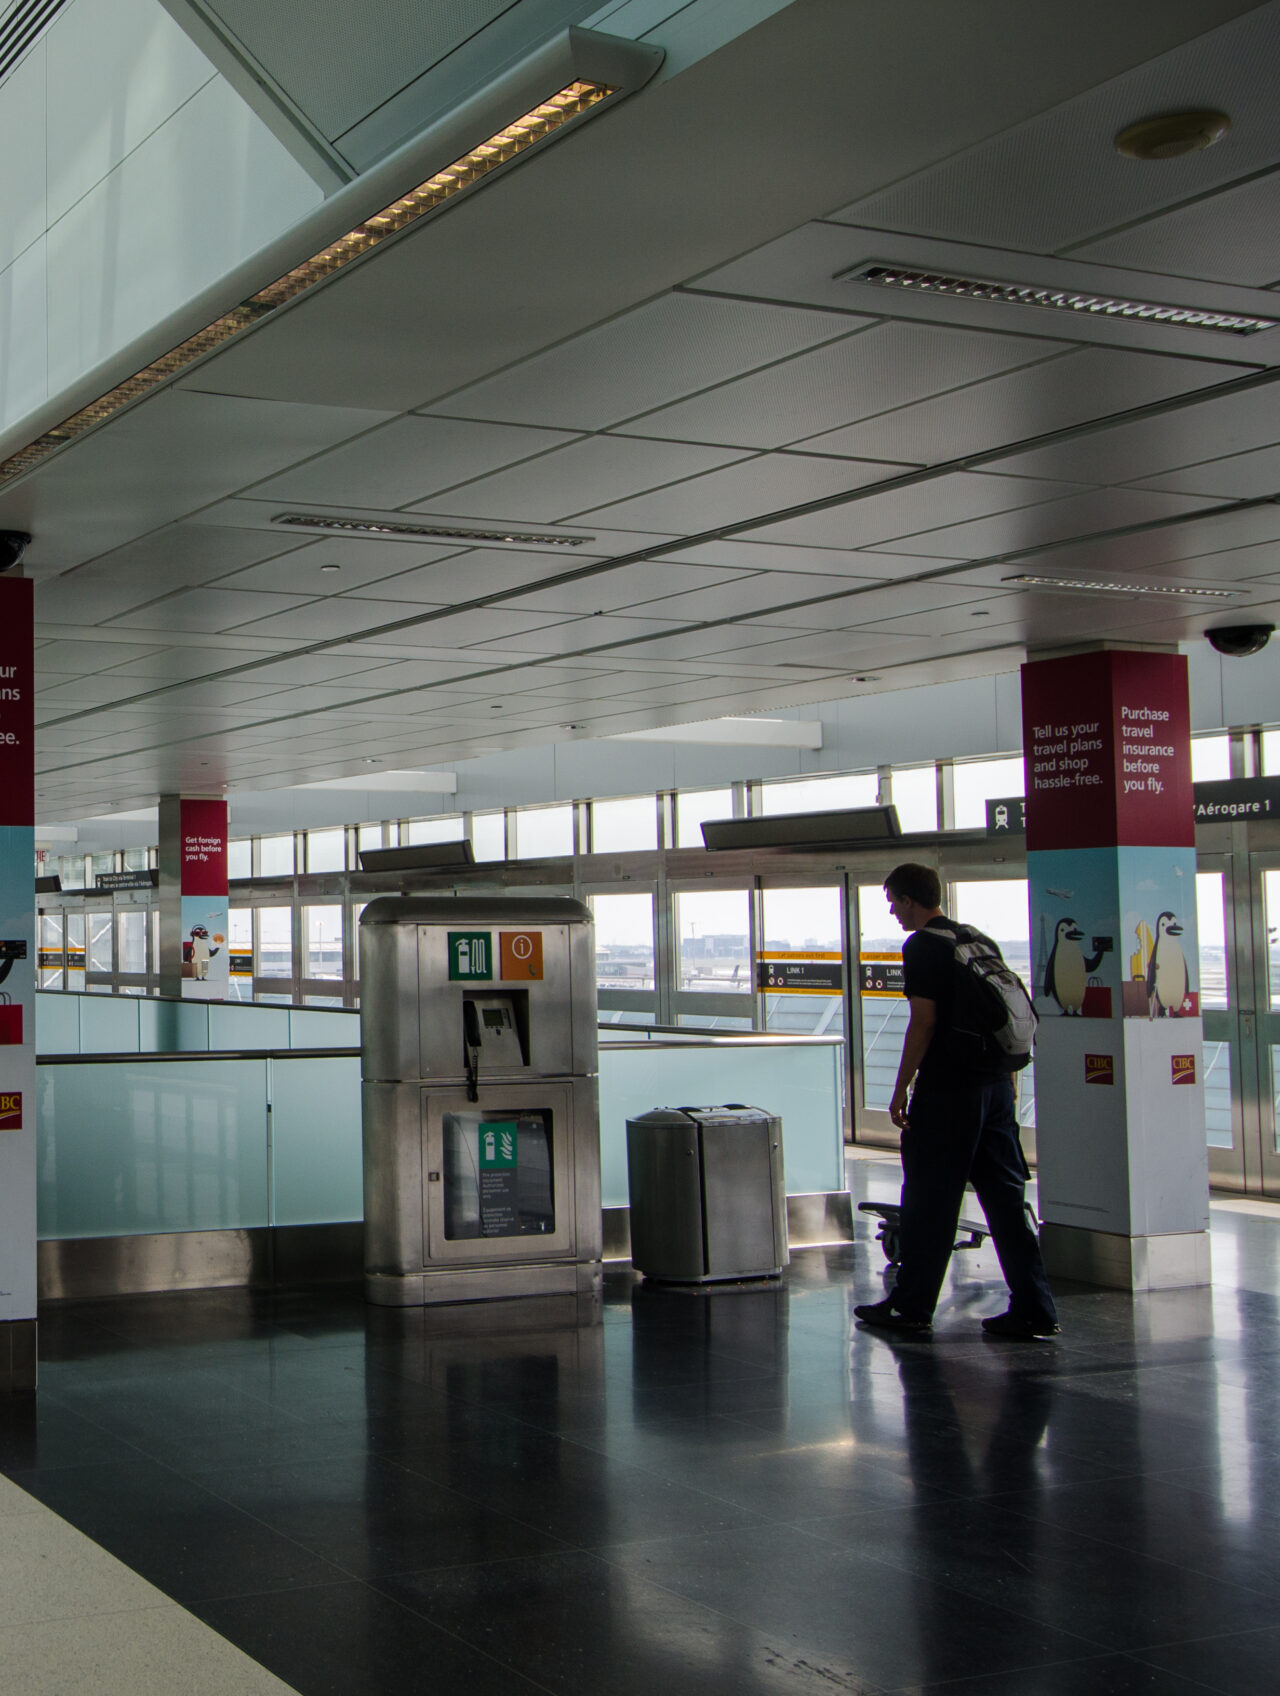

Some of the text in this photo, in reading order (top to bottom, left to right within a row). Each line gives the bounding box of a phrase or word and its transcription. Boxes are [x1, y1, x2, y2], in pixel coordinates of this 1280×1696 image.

[1122, 706, 1170, 721] Purchase
[1032, 722, 1099, 739] Tell us your
[1122, 724, 1154, 738] travel
[1033, 738, 1102, 756] travel plans
[1122, 741, 1174, 756] insurance
[1034, 757, 1088, 772] and shop
[1124, 759, 1160, 774] before
[1034, 773, 1103, 789] hassle-free.
[1124, 778, 1164, 794] you fly.
[1192, 800, 1271, 817] 'Aérogare 1
[186, 836, 221, 845] Get foreign
[36, 850, 45, 862] TIE
[186, 853, 208, 862] you fly.
[886, 969, 902, 977] LINK
[1087, 1056, 1112, 1069] CIBC
[1173, 1058, 1194, 1069] CIBC
